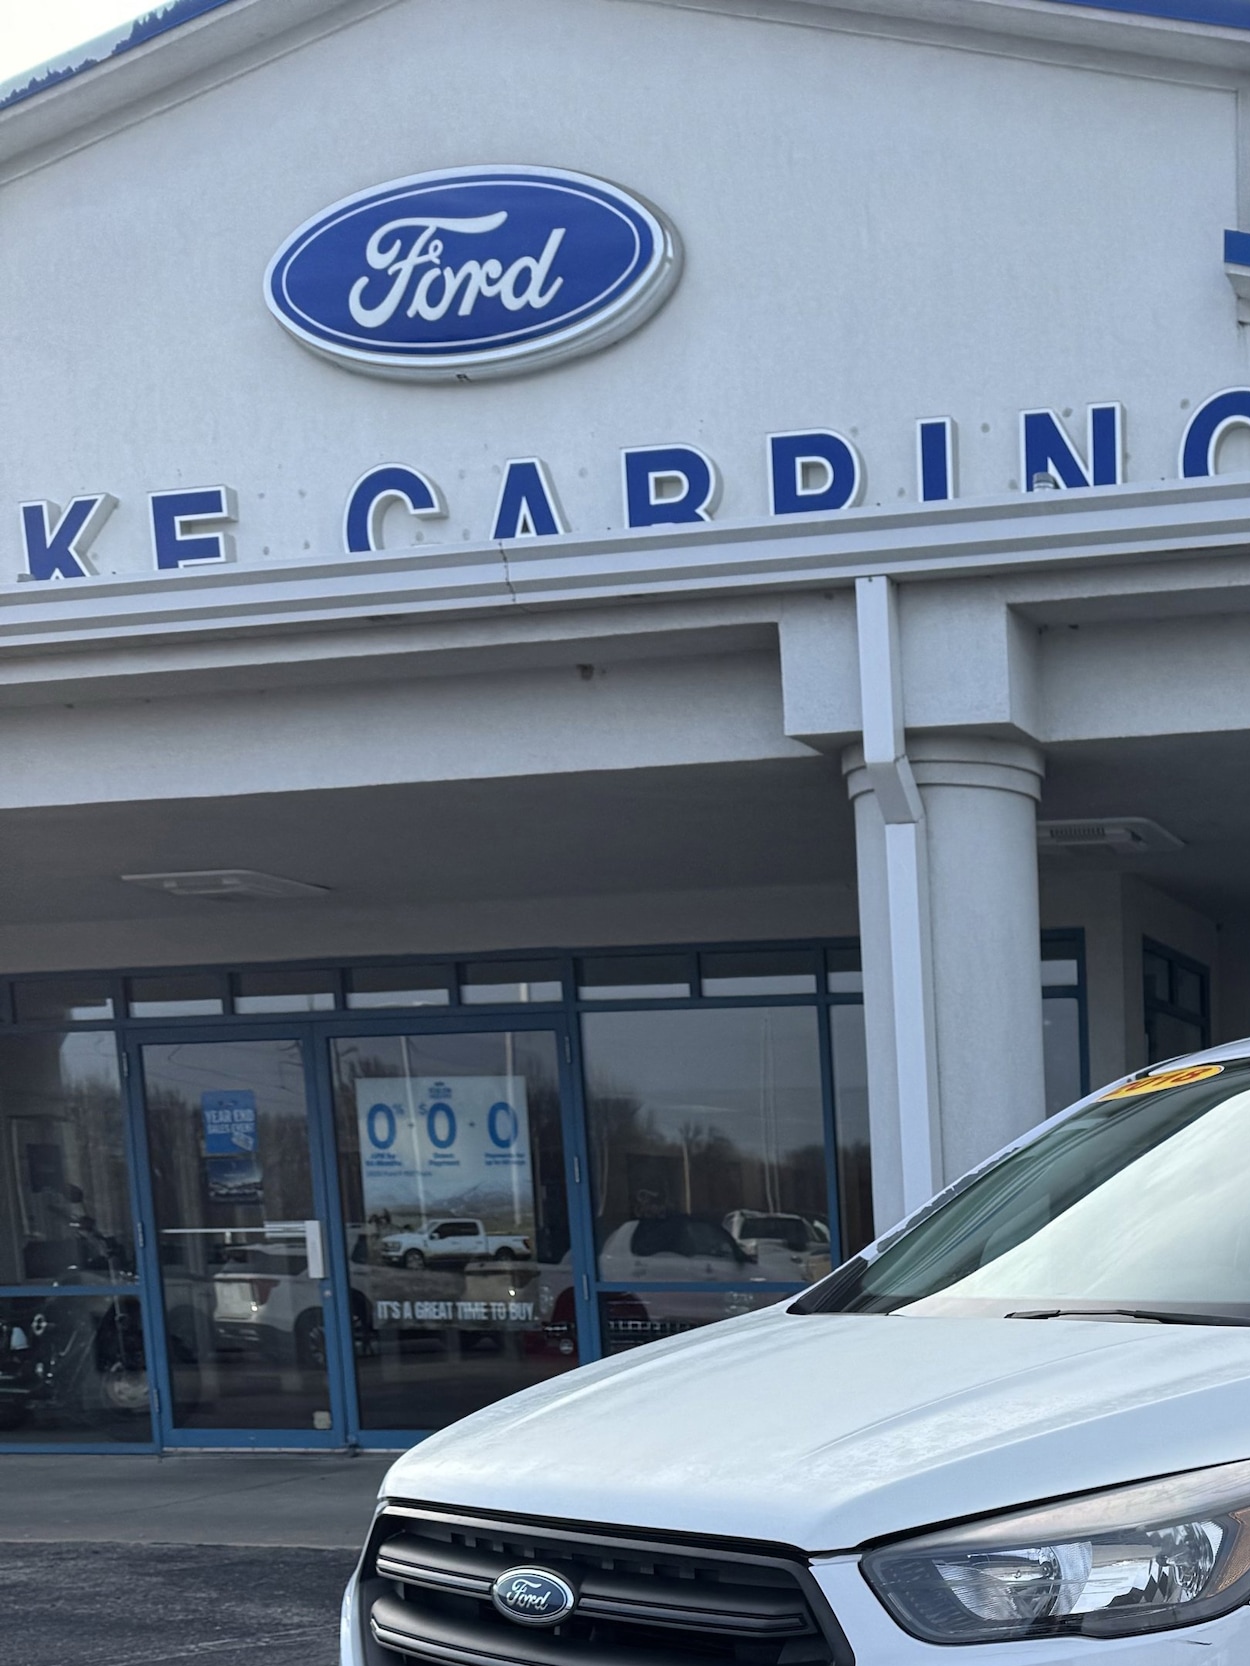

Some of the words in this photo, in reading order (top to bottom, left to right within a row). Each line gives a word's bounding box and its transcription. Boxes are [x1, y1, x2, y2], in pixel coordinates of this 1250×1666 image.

[347, 210, 567, 328] Ford
[204, 1109, 232, 1123] YEAR
[377, 1300, 400, 1320] IT'S
[403, 1301, 412, 1320] A
[414, 1301, 453, 1320] GREAT
[456, 1301, 488, 1320] TIME
[490, 1302, 507, 1320] TO
[508, 1302, 539, 1321] BUY.
[505, 1578, 552, 1611] Ford
